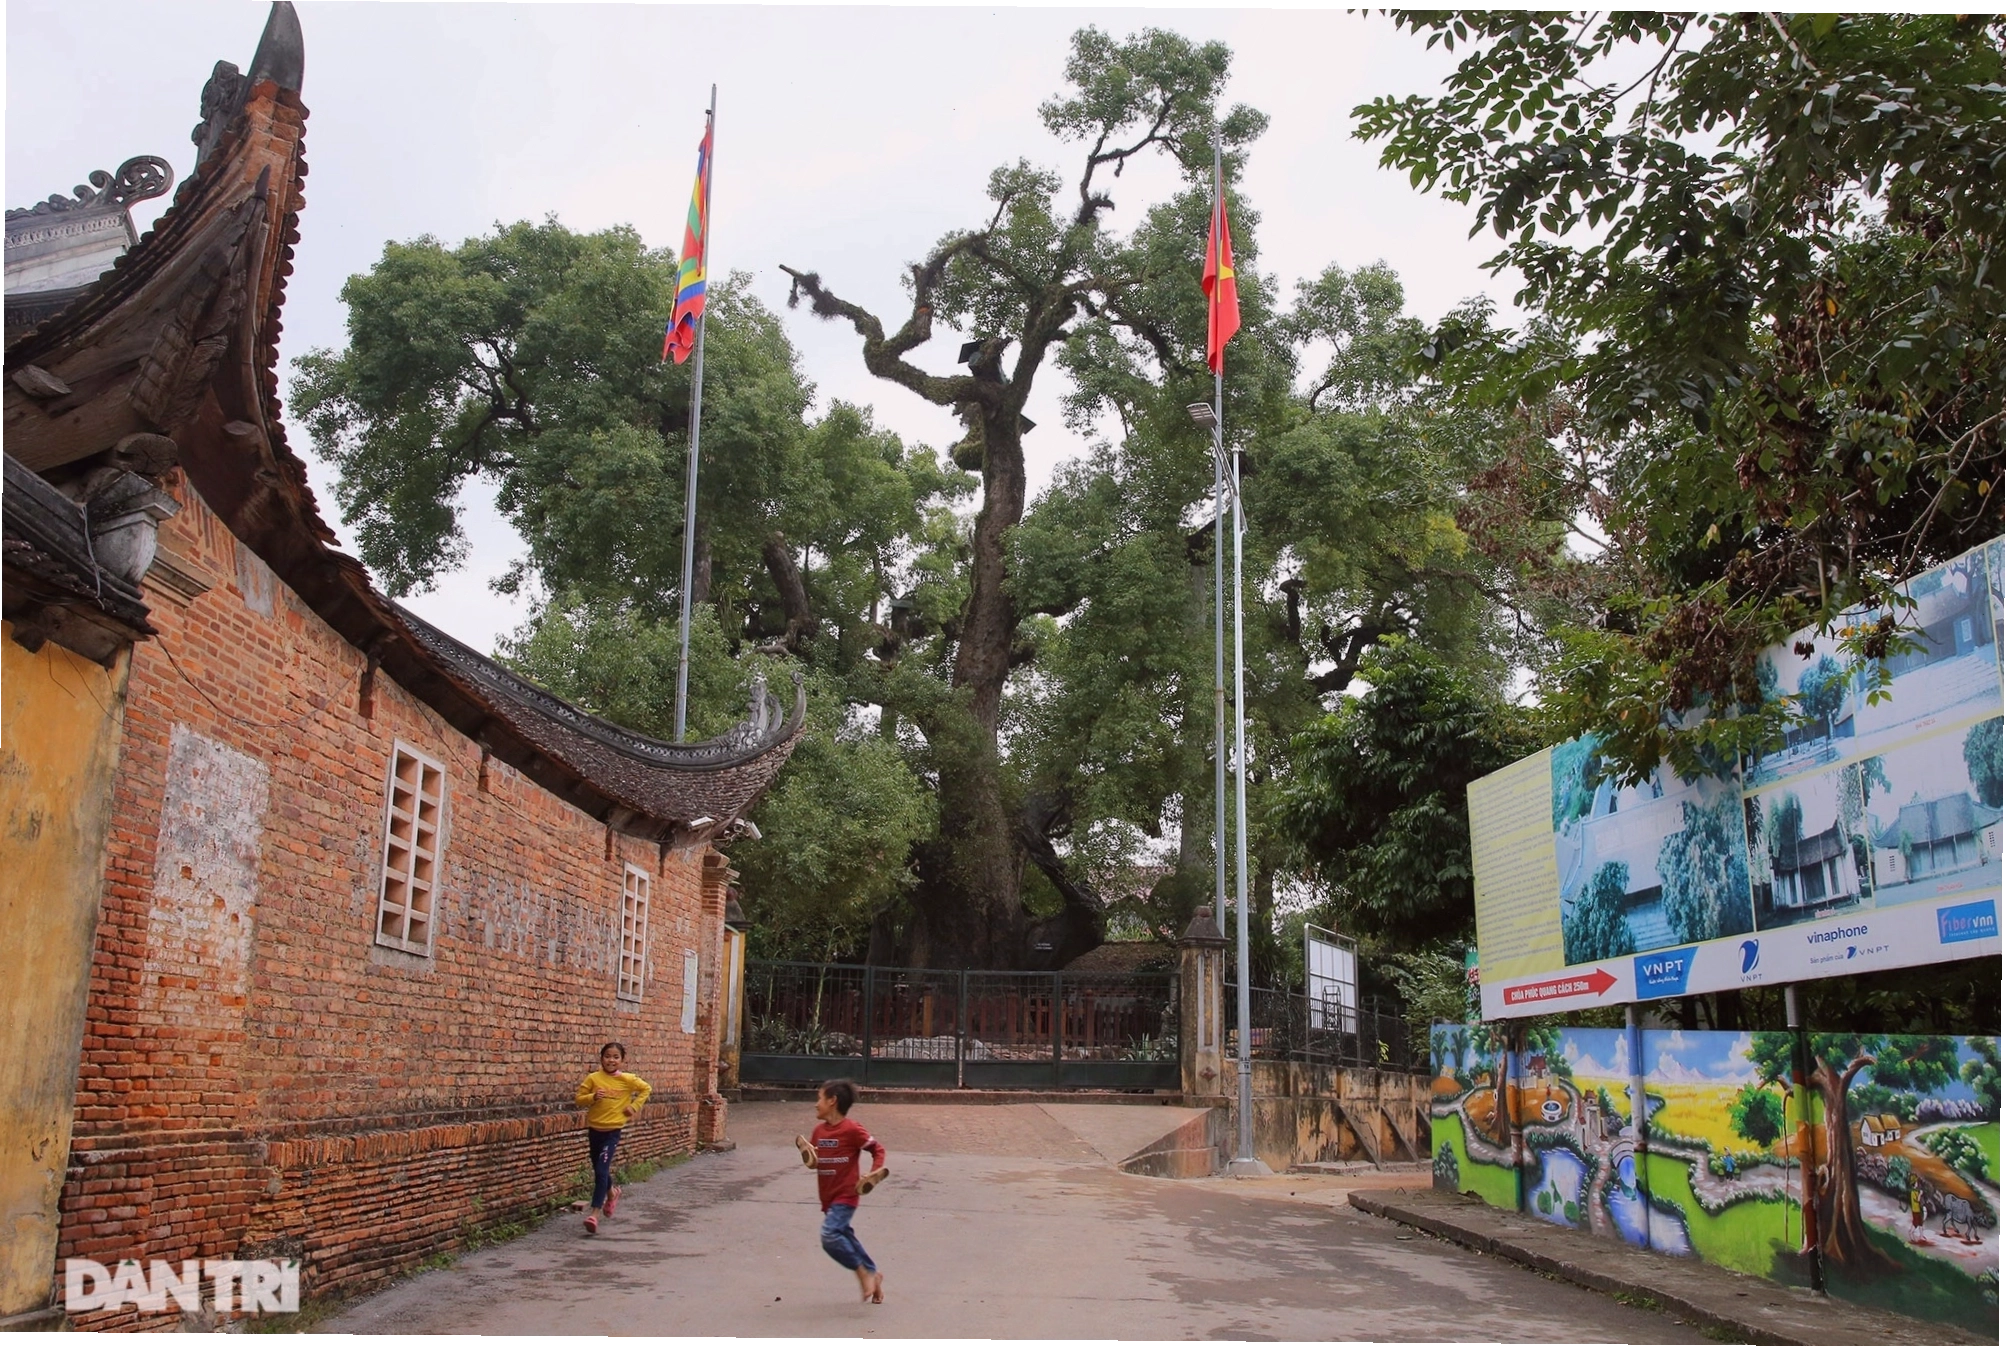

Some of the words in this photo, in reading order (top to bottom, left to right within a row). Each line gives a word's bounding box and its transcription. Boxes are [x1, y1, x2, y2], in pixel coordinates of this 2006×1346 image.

[1807, 925, 1868, 944] vinaphone
[1859, 945, 1889, 955] VNPT
[1642, 959, 1683, 977] VNPT
[1740, 973, 1762, 982] VNPT
[1539, 984, 1557, 998] QUANG
[1557, 981, 1573, 994] CÁCH
[1573, 980, 1590, 992] 250m
